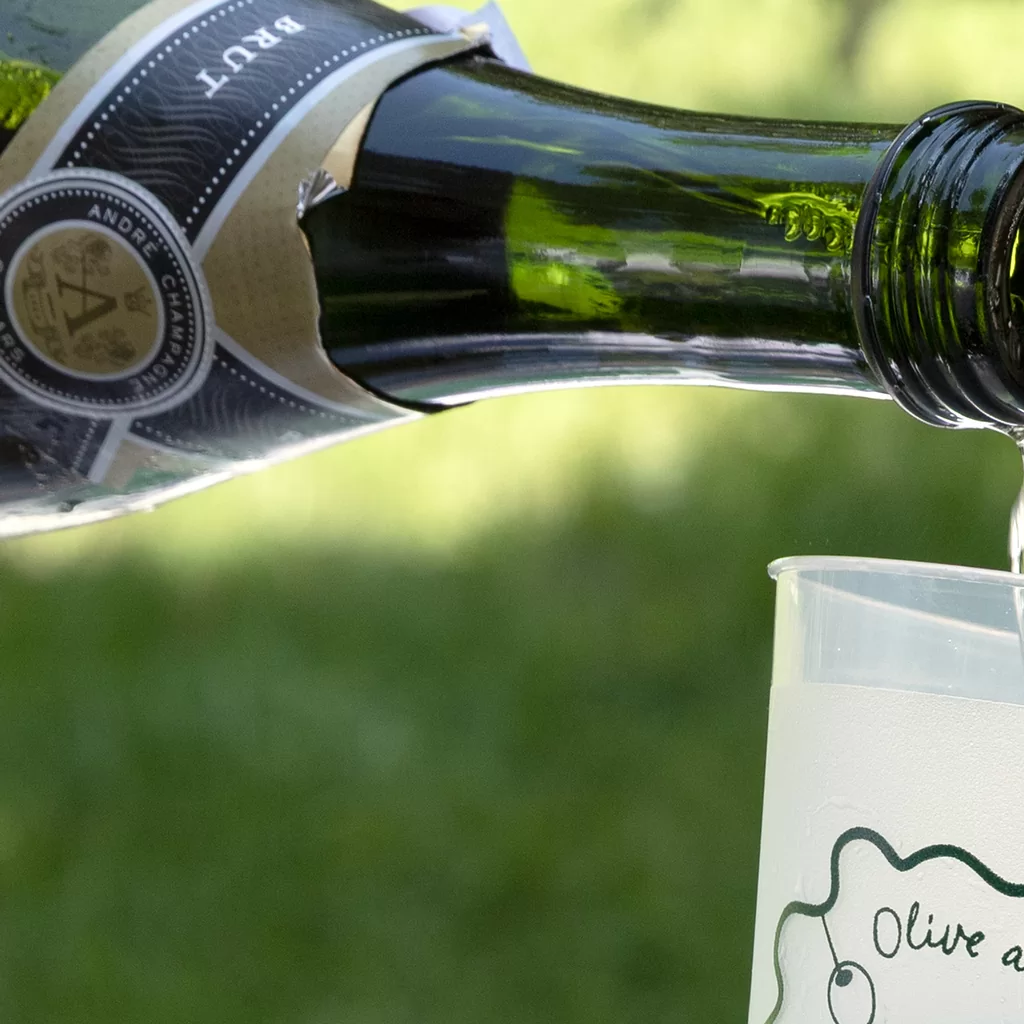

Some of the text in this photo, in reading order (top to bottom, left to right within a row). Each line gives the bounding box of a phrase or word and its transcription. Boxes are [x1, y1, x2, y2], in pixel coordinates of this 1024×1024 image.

[195, 14, 305, 99] BRUT
[129, 274, 184, 393] CHAMPAGNE
[873, 901, 985, 958] Olive
